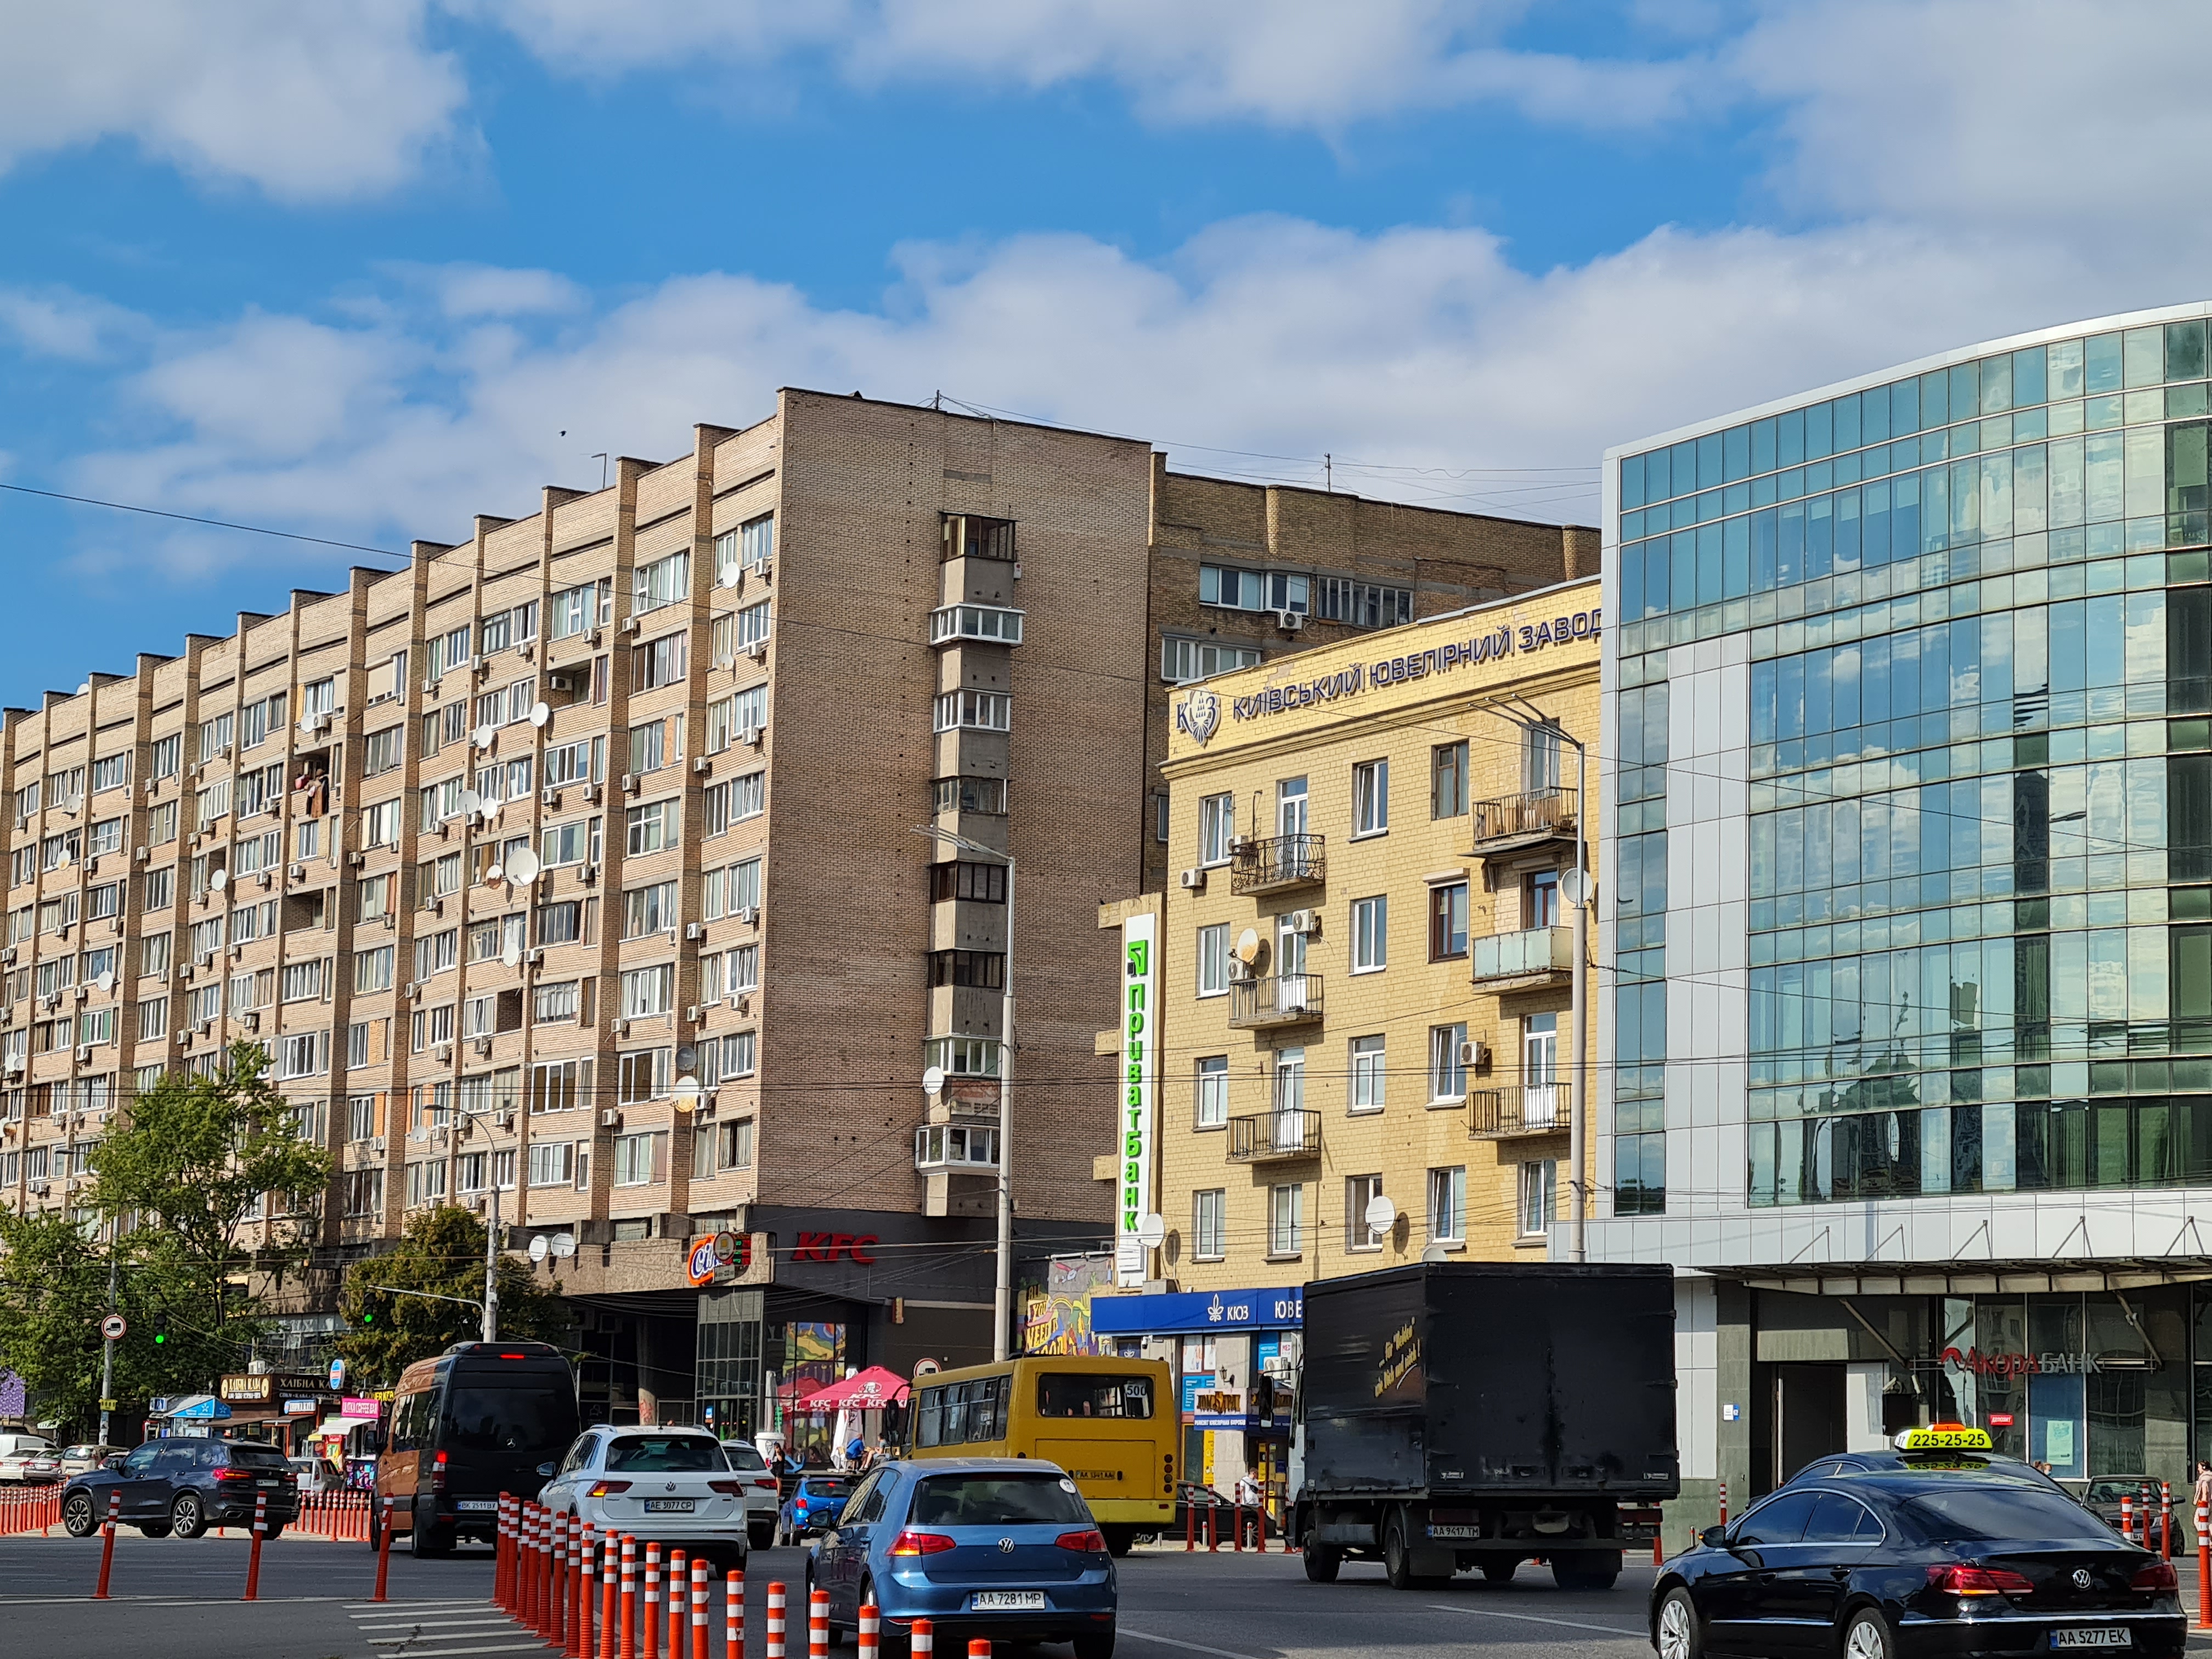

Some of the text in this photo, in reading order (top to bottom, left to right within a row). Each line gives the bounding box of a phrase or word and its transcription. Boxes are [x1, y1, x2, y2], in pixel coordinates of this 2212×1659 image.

[1234, 664, 1364, 720] КИЇВСЬКИЙ
[1371, 624, 1513, 685] ЮВЕЛІРНИЙ
[792, 1232, 879, 1264] KFC
[1227, 1305, 1249, 1321] КЮЗ
[1127, 1385, 1147, 1396] 500
[809, 1399, 832, 1407] KFC
[1913, 1434, 1985, 1446] 225-25-25
[651, 1501, 692, 1509] AE 3077 CP
[979, 1593, 1041, 1605] AA 7281 MP
[2058, 1629, 2127, 1645] AA 5277 EK
